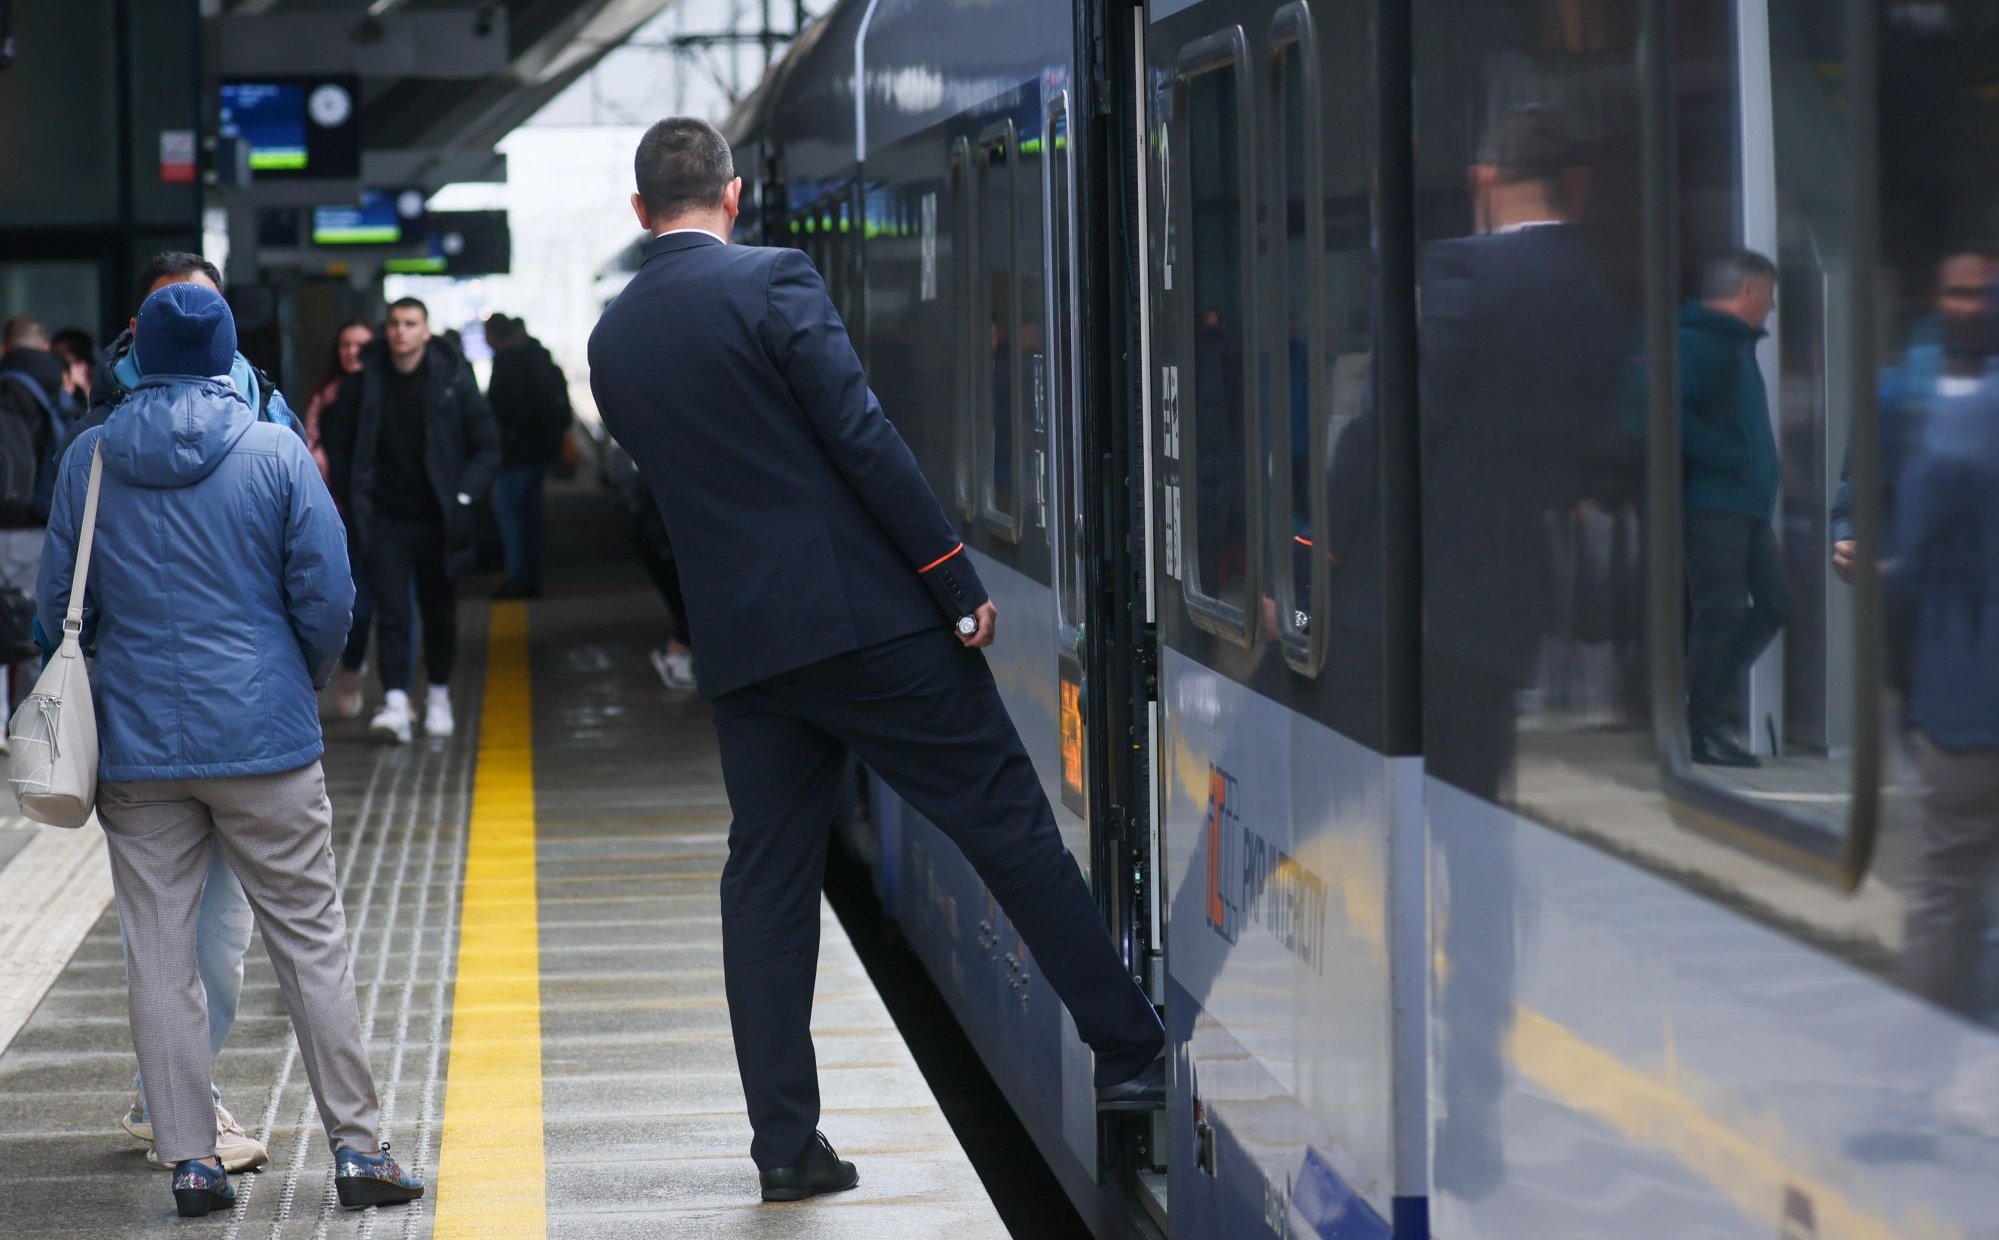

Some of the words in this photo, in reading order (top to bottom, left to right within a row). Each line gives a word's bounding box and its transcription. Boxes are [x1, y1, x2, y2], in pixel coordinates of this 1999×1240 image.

[1162, 121, 1173, 290] 2
[1242, 826, 1267, 925] PKP
[1267, 842, 1329, 977] INTERCITY
